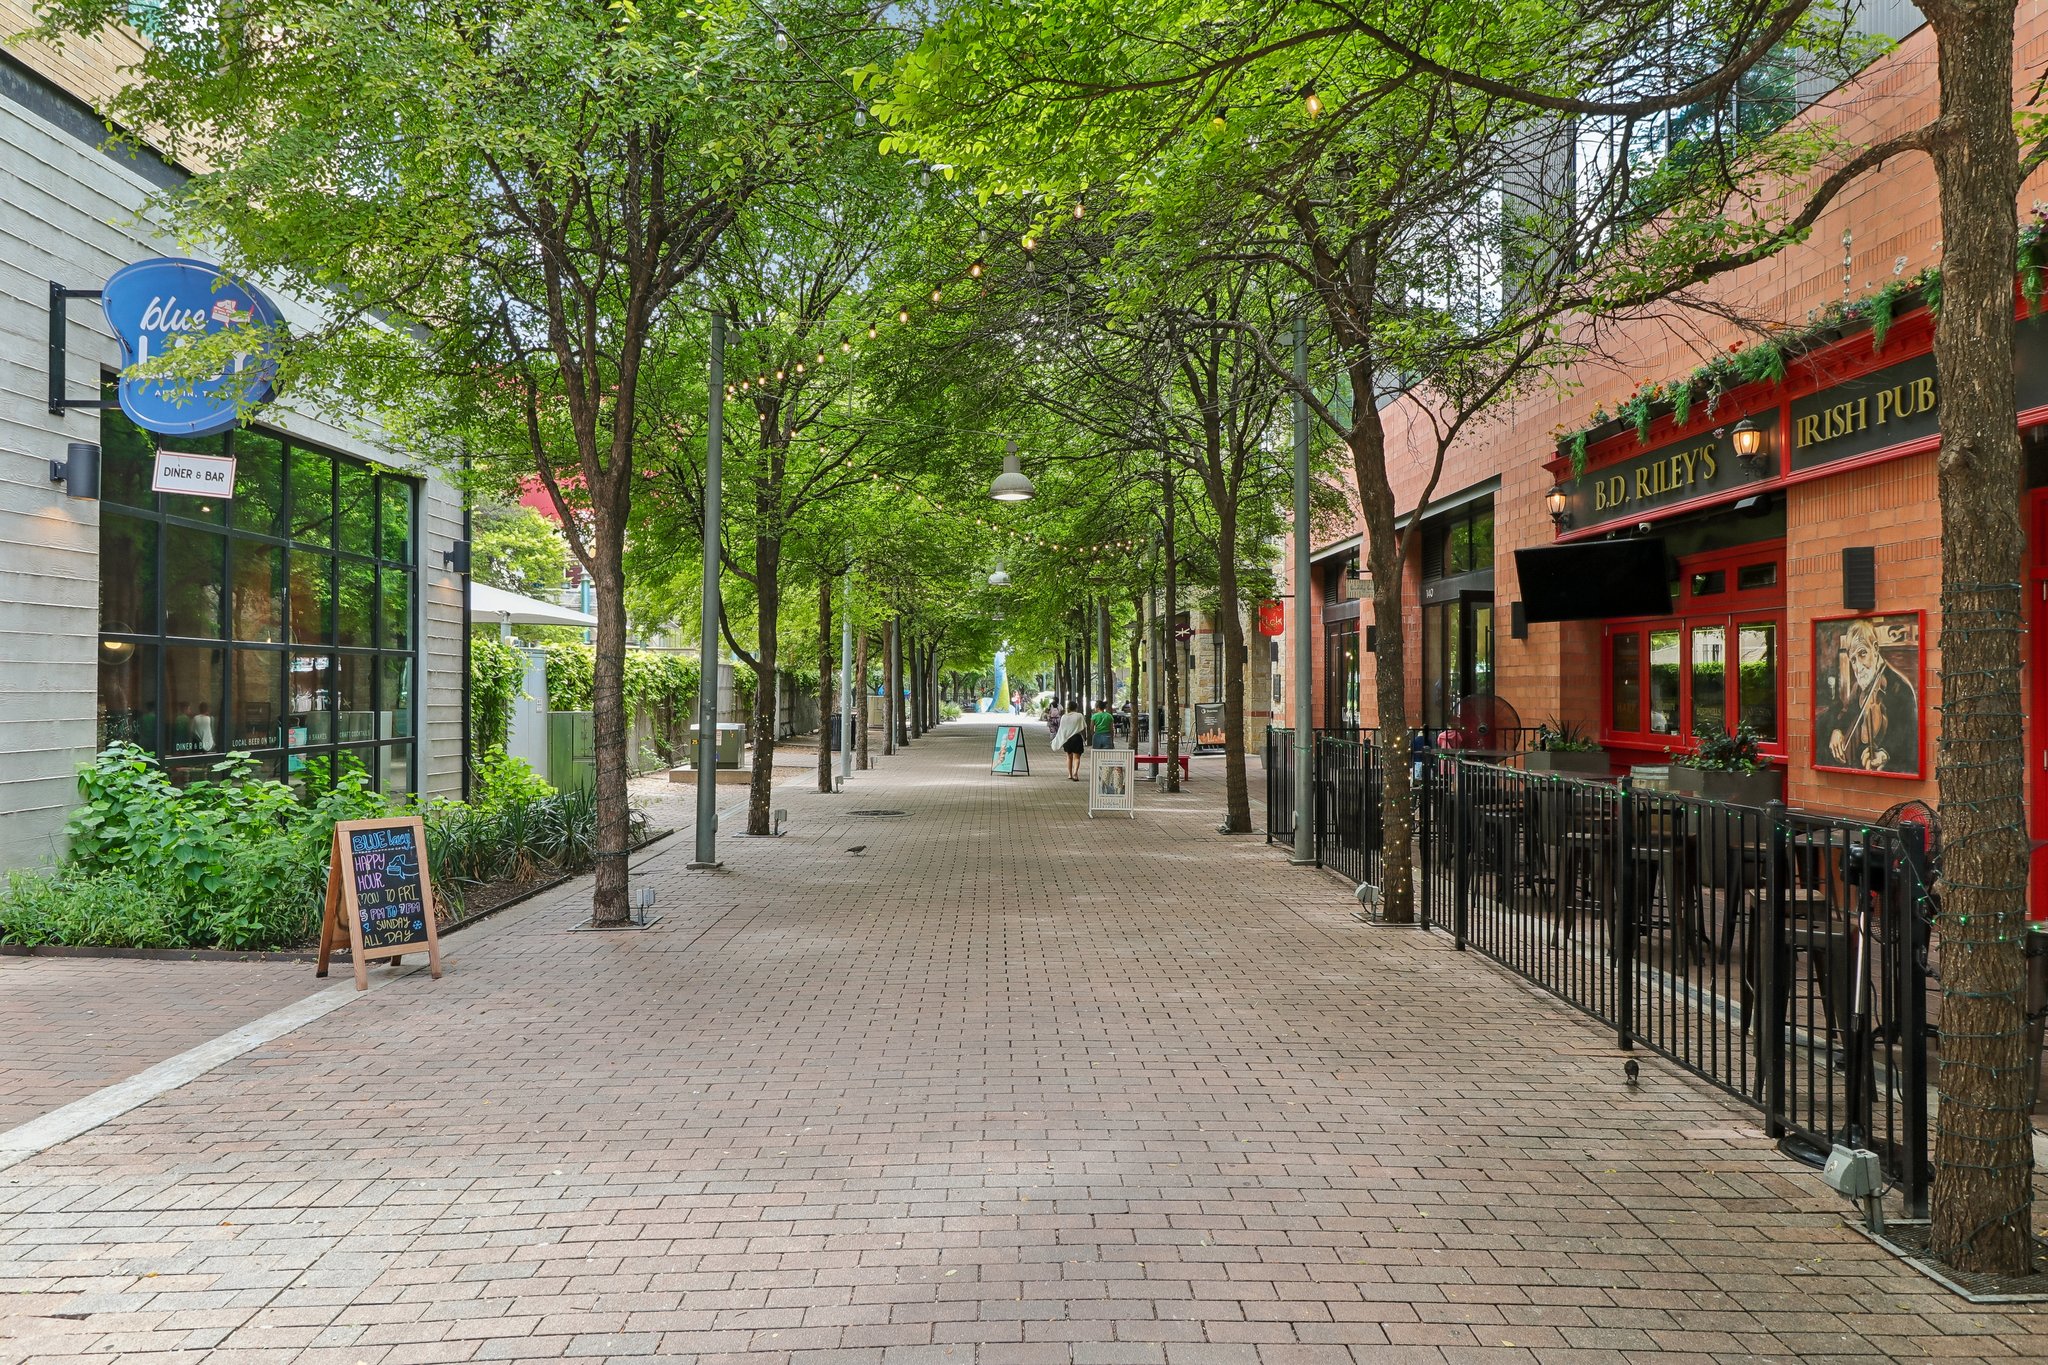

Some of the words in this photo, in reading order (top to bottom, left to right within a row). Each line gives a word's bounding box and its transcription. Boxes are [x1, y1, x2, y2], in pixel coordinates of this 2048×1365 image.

[140, 296, 209, 332] blue
[1796, 397, 1867, 449] IRISH
[1876, 376, 1936, 425] PUB
[164, 466, 193, 479] DINER
[196, 471, 202, 480] &
[205, 471, 225, 482] BAR
[1595, 475, 1631, 511] B.D.
[1635, 443, 1716, 500] RILEY'S
[232, 739, 248, 747] LOCAL
[248, 737, 260, 746] BEER
[352, 831, 388, 852] BLUE
[355, 853, 386, 872] HAPPY
[357, 872, 386, 892] HOUR
[385, 888, 396, 903] TO
[398, 884, 420, 902] FRI
[370, 907, 386, 920] PM
[385, 904, 398, 918] TO
[376, 916, 411, 931] SUNDAY
[364, 934, 383, 948] ALL
[384, 930, 415, 944] DAY
